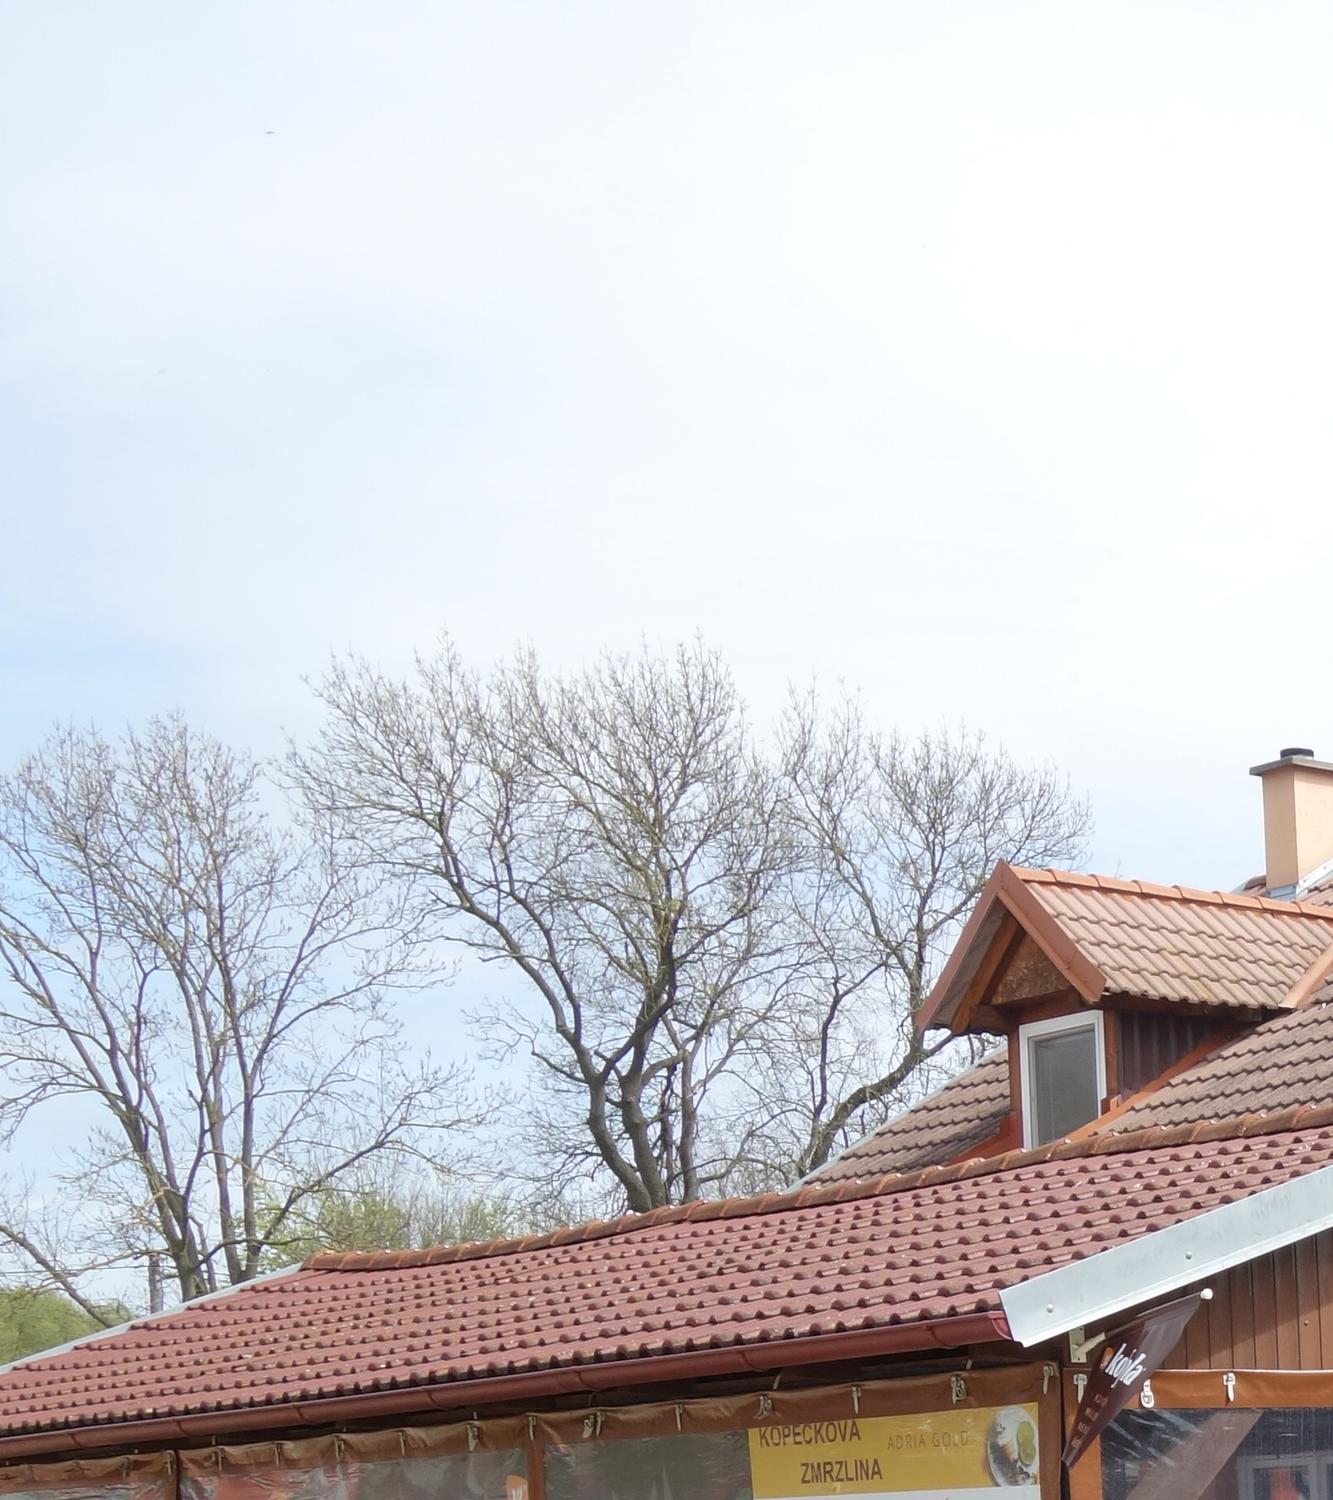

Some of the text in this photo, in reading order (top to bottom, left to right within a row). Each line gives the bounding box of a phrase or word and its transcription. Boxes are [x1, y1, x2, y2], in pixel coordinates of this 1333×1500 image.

[887, 1430, 969, 1450] ADRIA GOLD
[800, 1458, 883, 1484] ZMRZLINA
